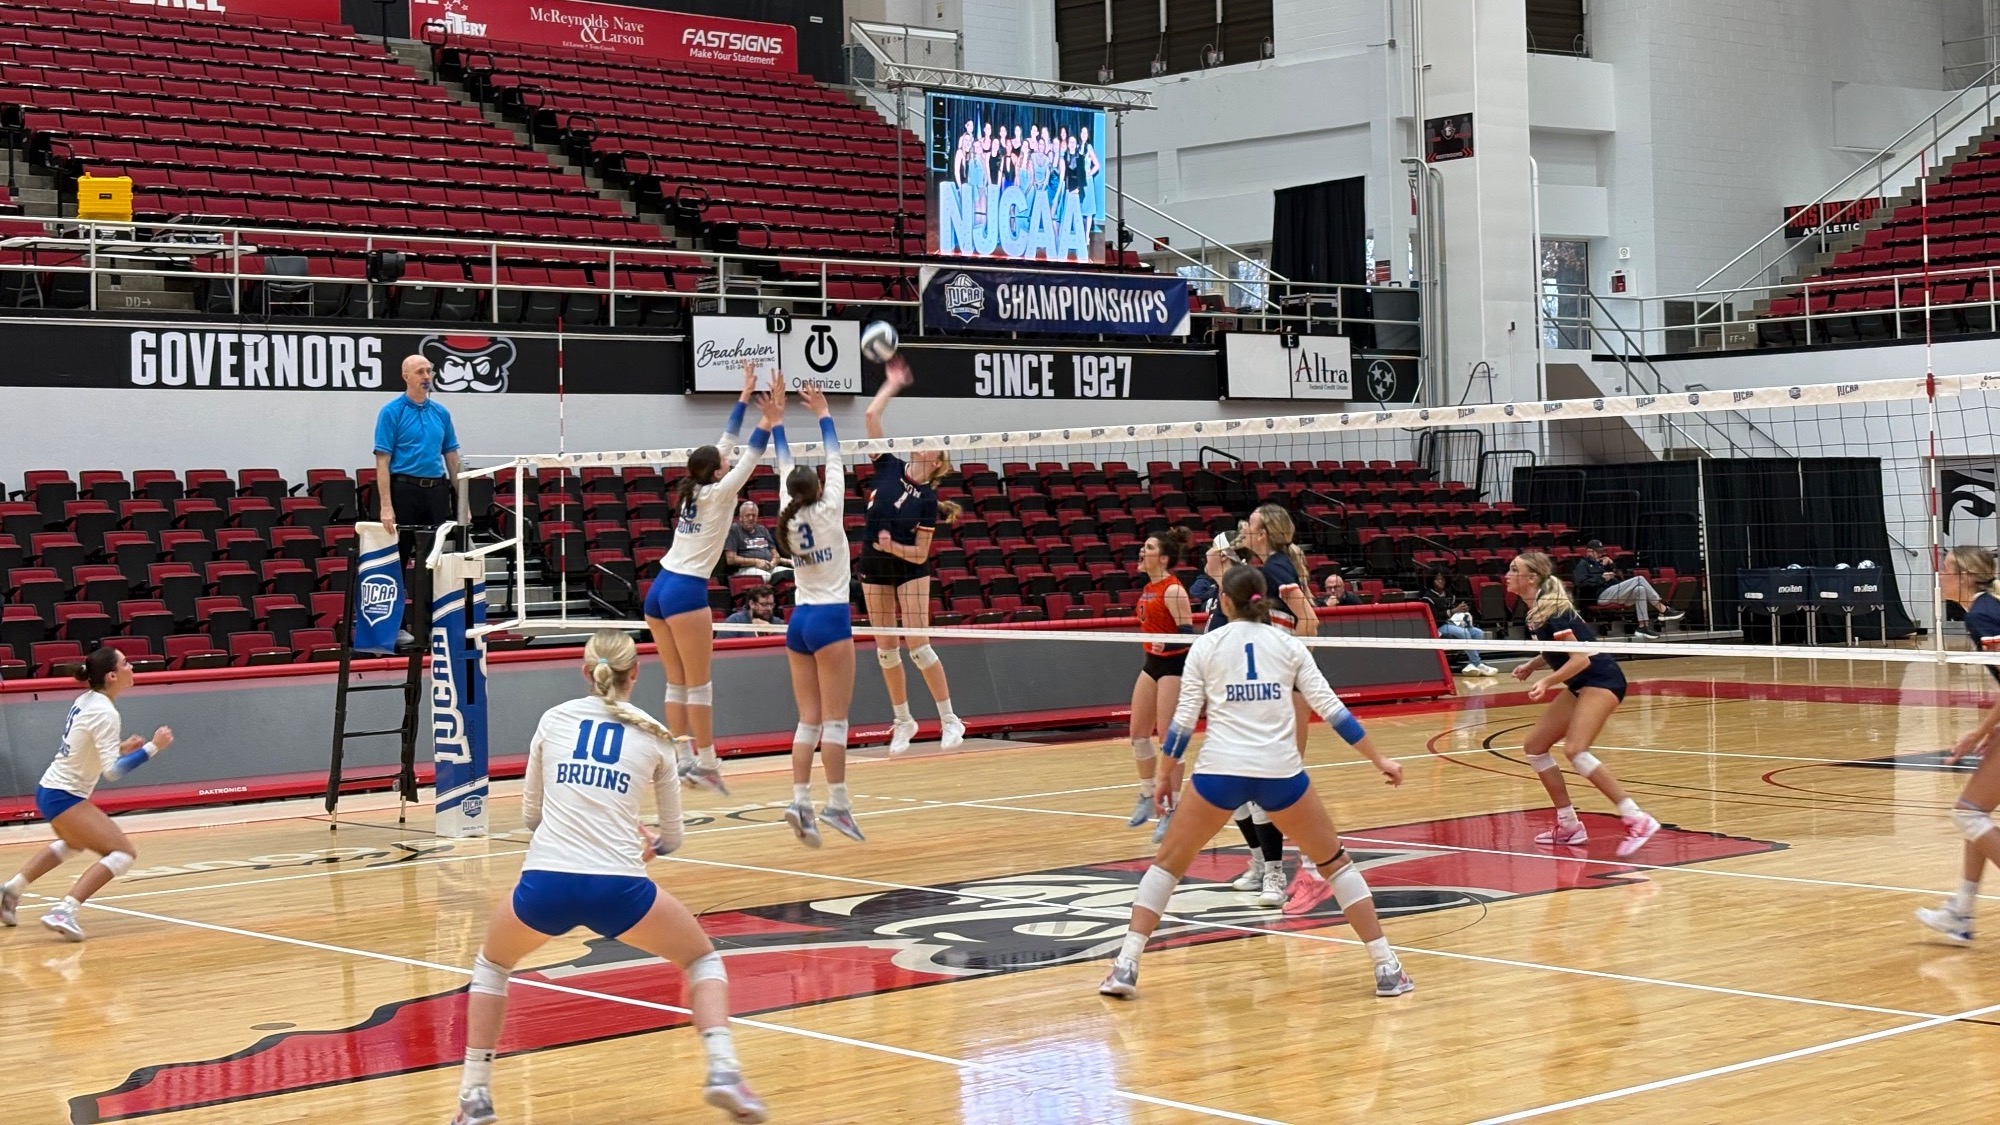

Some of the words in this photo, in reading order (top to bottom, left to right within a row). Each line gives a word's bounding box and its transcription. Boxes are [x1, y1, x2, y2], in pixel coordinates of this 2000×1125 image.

[529, 6, 609, 28] McReynolds
[613, 16, 645, 33] Nave
[581, 15, 602, 44] &
[601, 28, 645, 46] Larson
[681, 28, 783, 54] FASTSIGNS
[689, 48, 712, 59] Make
[712, 50, 732, 61] Your
[732, 52, 775, 65] Statement
[939, 181, 1089, 261] NJCAA
[996, 283, 1169, 324] CHAMPIONSHIPS
[774, 317, 786, 332] D
[696, 337, 775, 368] Beachaven
[1287, 334, 1295, 347] E
[130, 330, 383, 388] GOVERNORS
[1294, 347, 1350, 384] Altra
[843, 377, 853, 389] U
[974, 352, 1055, 397] SINCE
[1071, 354, 1132, 398] 1927
[797, 522, 815, 550] 3
[1244, 642, 1258, 680] 1
[432, 632, 466, 760] NJCAA
[1225, 682, 1282, 702] BRUINS
[572, 719, 625, 765] 10
[556, 763, 631, 795] BRUINS
